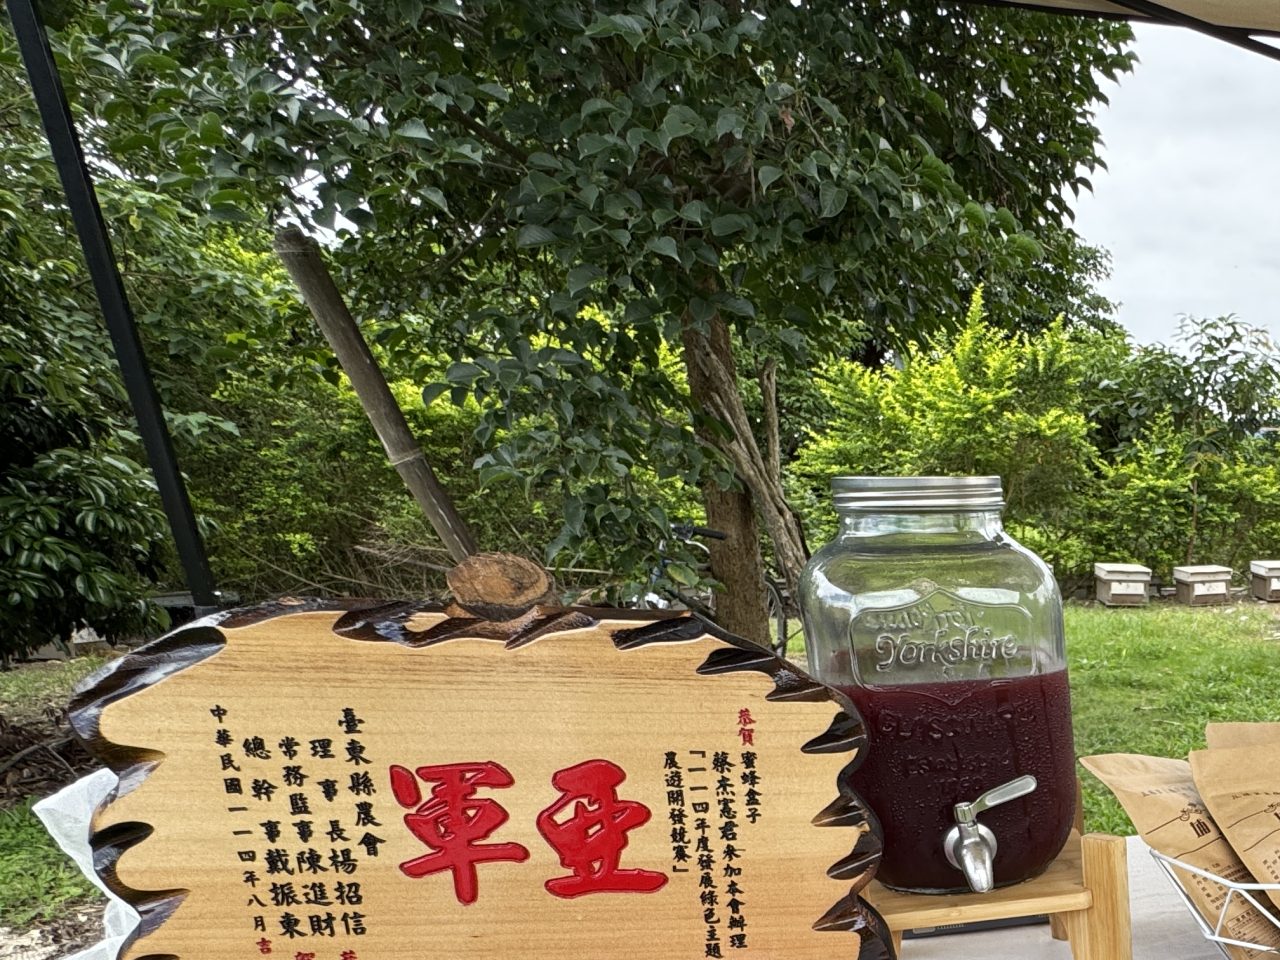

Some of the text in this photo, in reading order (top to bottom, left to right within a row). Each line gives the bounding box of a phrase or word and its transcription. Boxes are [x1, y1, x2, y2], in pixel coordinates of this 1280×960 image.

[876, 625, 1019, 672] Yorkshire
[338, 707, 386, 857] 臺東縣農會
[737, 708, 762, 824] 恭賀 蜜蜂盒子
